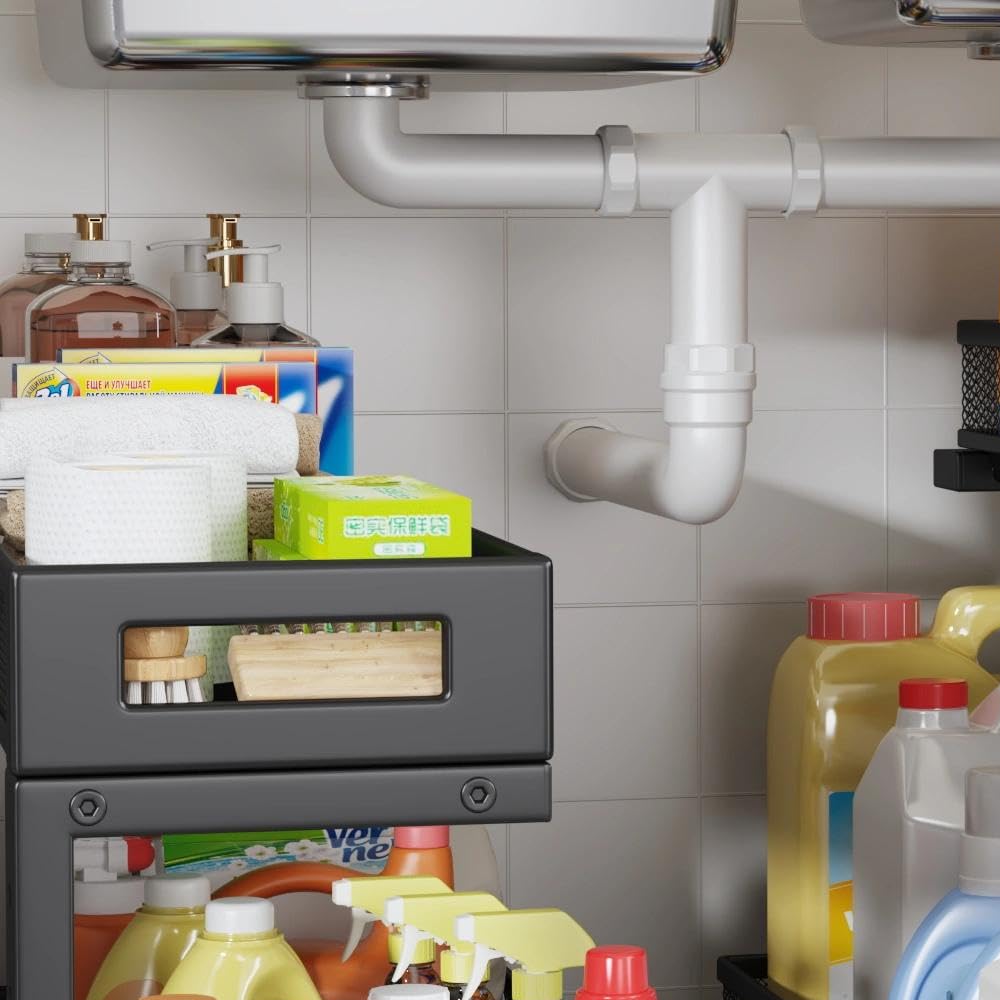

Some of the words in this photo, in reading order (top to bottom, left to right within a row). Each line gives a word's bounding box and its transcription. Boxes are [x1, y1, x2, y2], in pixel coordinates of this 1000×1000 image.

[86, 380, 103, 390] ЕЩЕ
[104, 380, 110, 389] И
[111, 380, 151, 390] УЛУЧШАЕТ
[342, 842, 394, 863] ne
